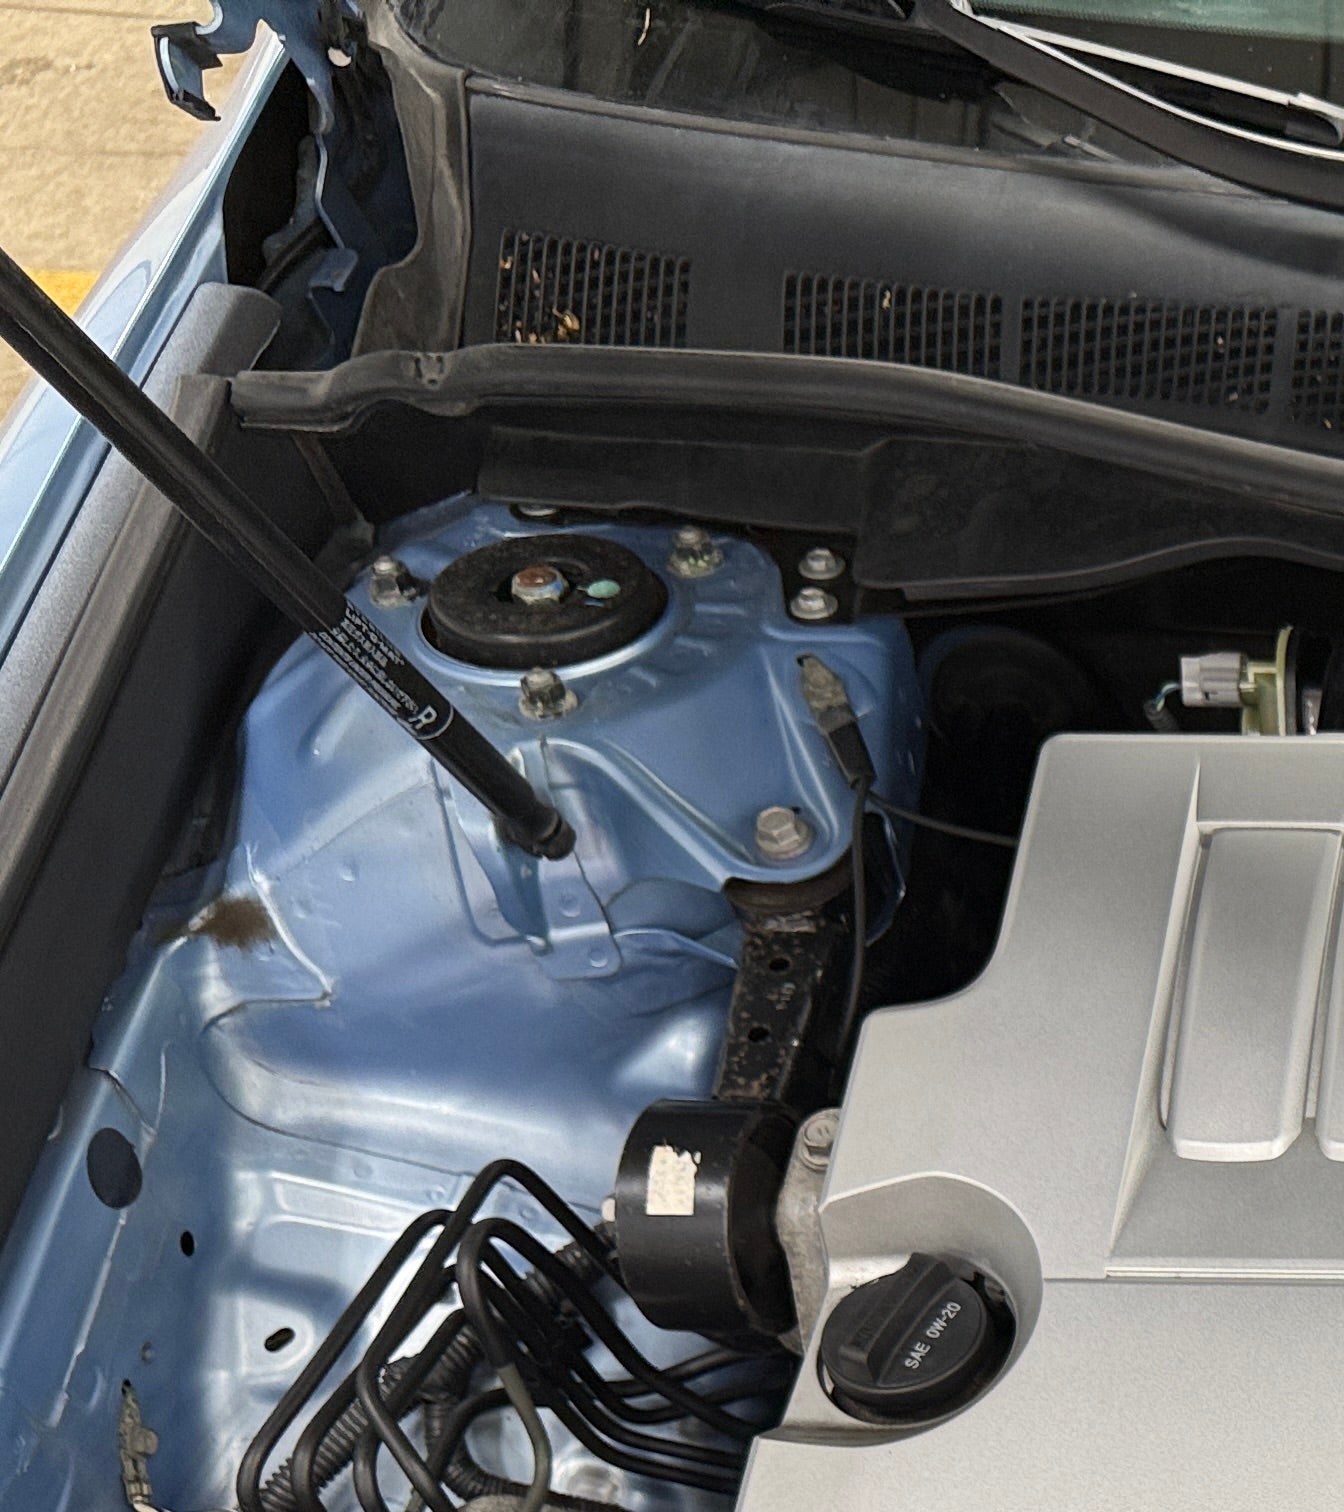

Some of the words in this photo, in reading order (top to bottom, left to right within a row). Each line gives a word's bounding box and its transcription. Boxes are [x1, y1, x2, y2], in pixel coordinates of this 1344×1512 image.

[409, 705, 437, 729] R
[904, 1341, 931, 1369] SAE
[926, 1302, 961, 1339] 0W-20
